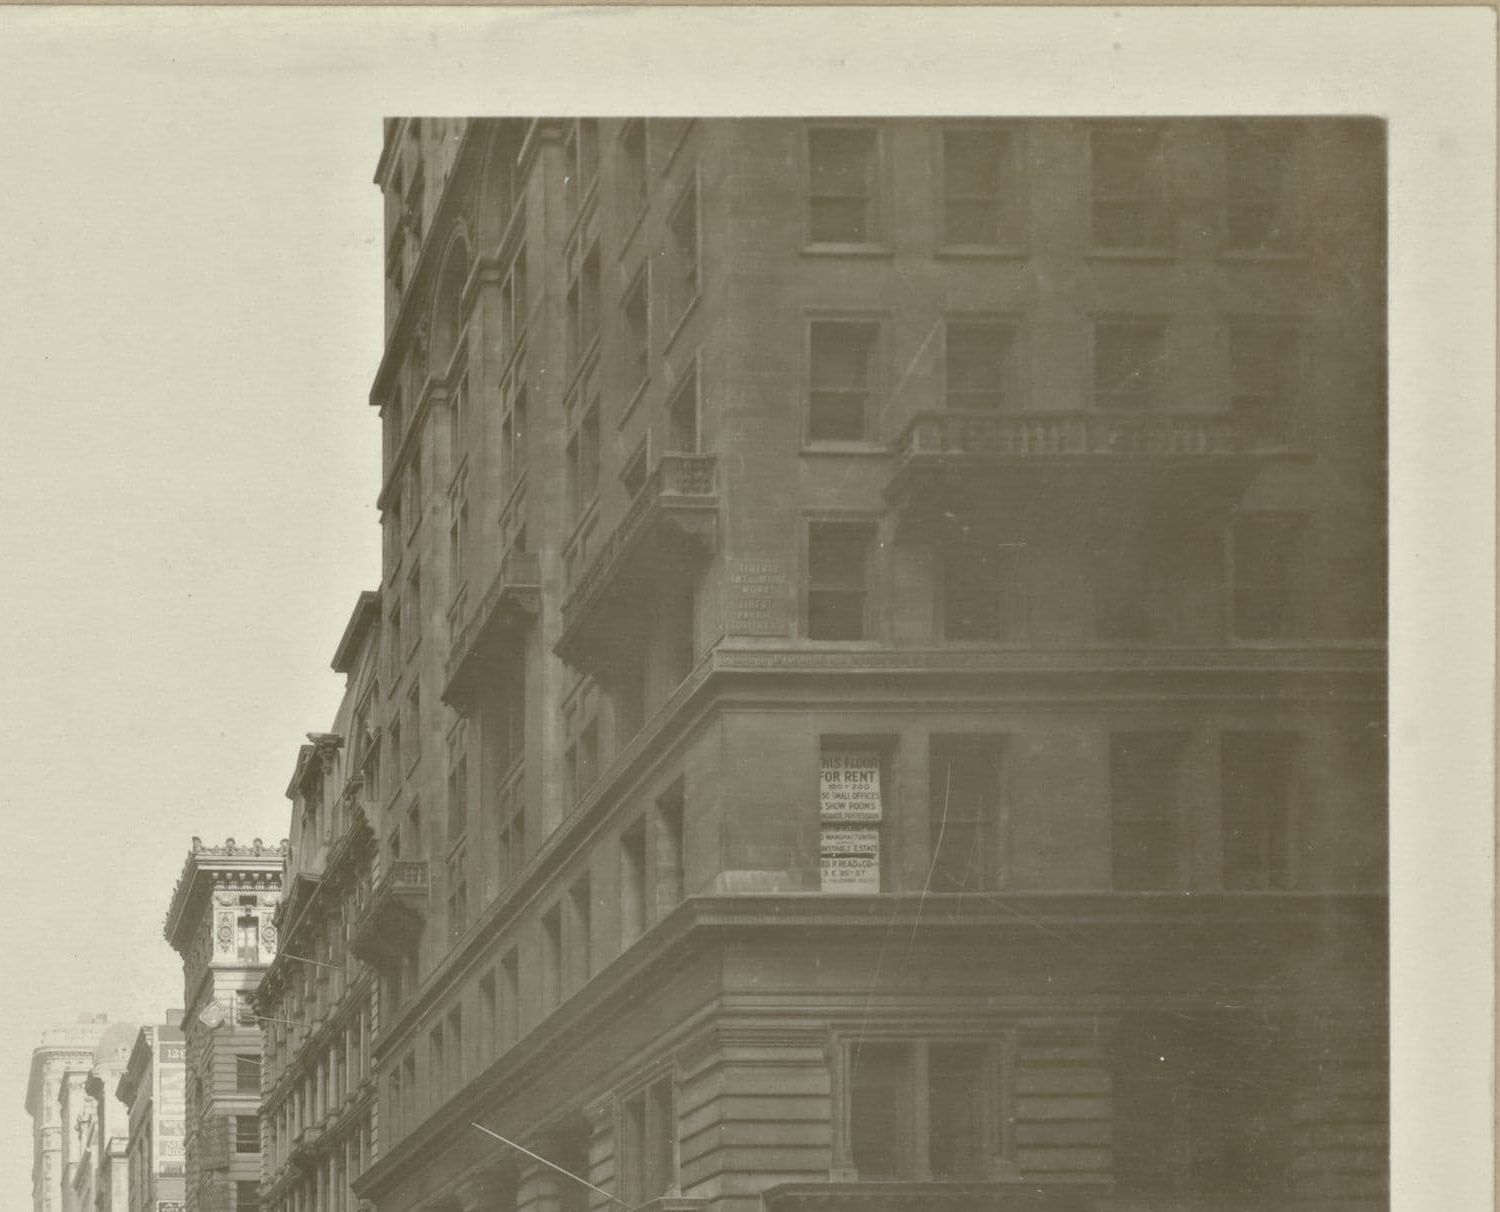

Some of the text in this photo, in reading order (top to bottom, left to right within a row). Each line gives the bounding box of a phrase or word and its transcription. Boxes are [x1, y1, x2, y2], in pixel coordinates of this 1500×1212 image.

[844, 770, 877, 783] RENT
[831, 791, 850, 800] SMALL
[851, 791, 880, 800] OFFICES
[825, 802, 876, 810] SHOW ROOMS
